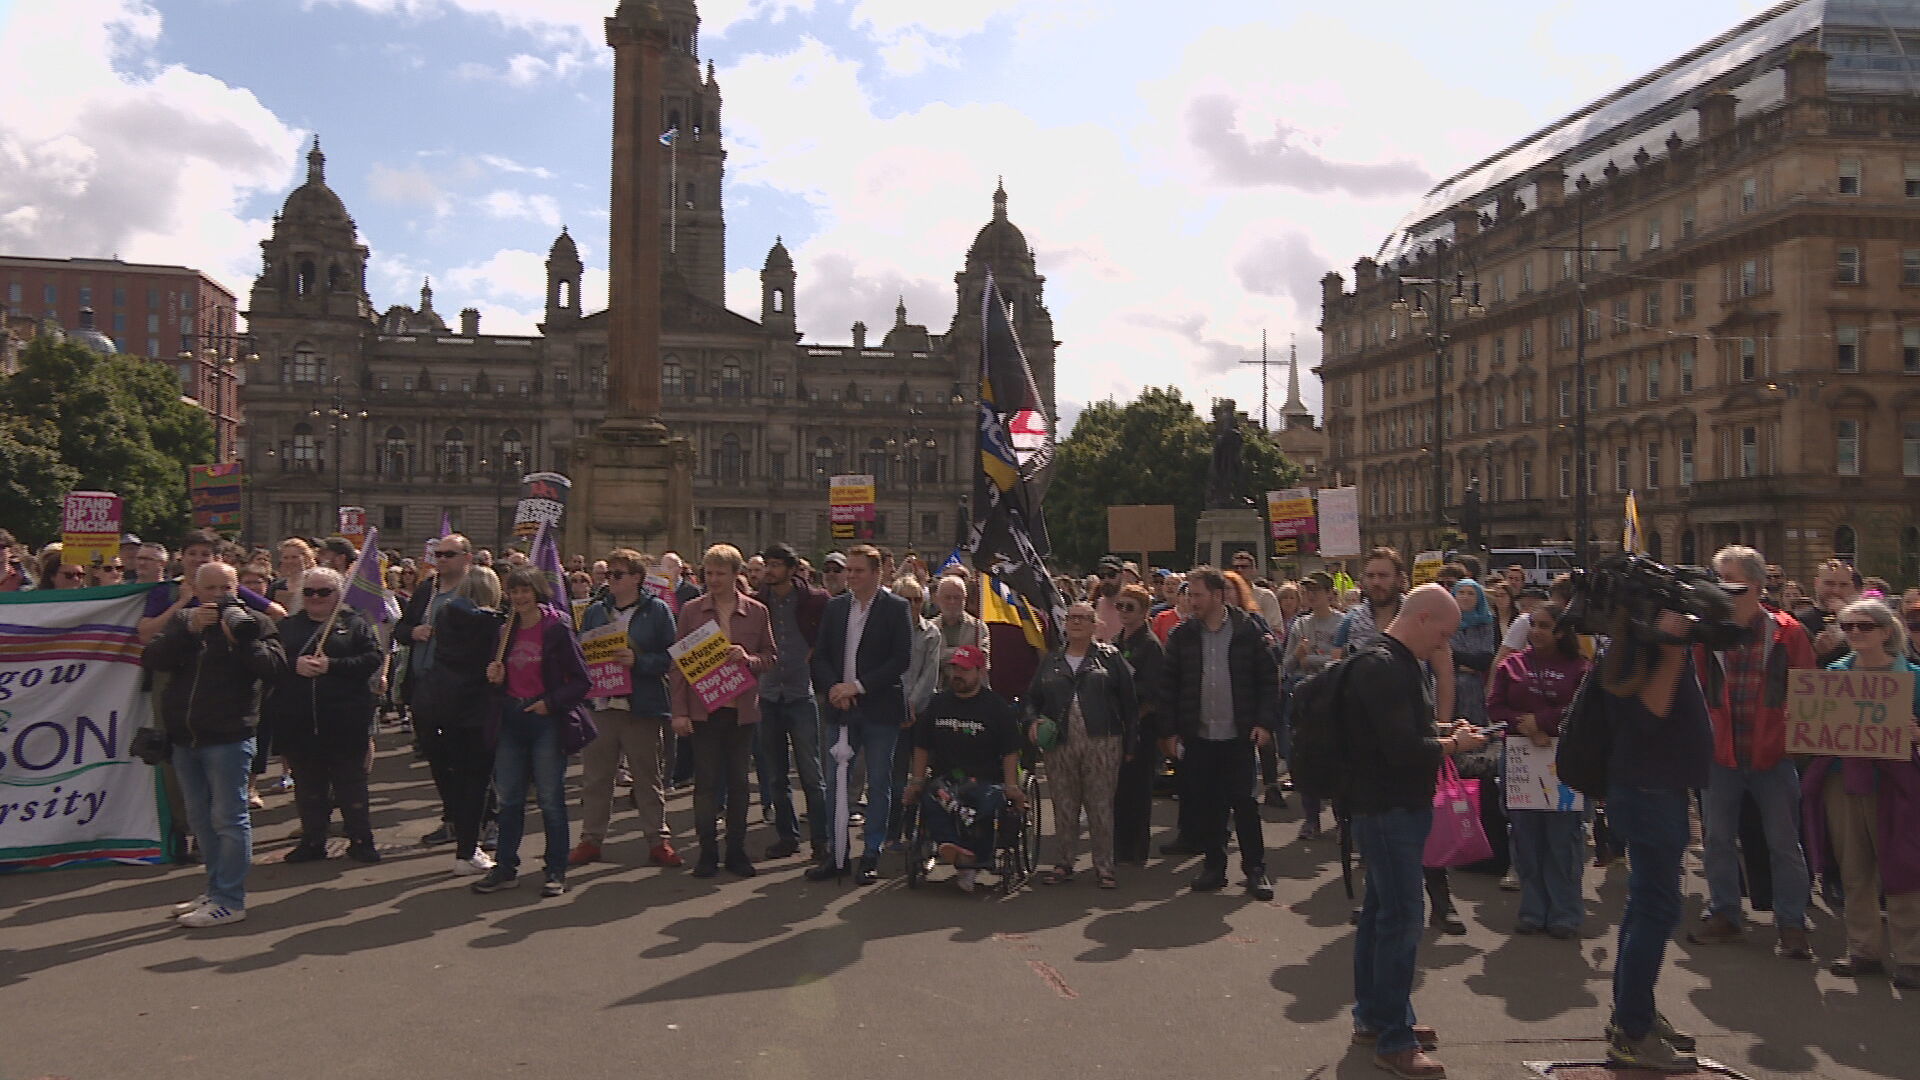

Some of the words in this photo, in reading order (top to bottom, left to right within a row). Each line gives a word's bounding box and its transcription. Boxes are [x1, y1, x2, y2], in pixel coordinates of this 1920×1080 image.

[67, 497, 113, 510] STAND
[67, 509, 88, 520] UP
[91, 509, 109, 521] TO
[66, 520, 120, 533] RACISM
[680, 637, 727, 669] Refugees
[605, 663, 624, 675] the
[695, 674, 721, 694] Stop
[719, 663, 739, 679] the
[597, 675, 625, 691] right
[703, 687, 721, 704] far
[720, 672, 747, 695] right
[1794, 674, 1899, 699] STAND
[1798, 699, 1838, 721] UP
[1854, 701, 1887, 724] TO
[0, 711, 118, 770] ON
[1792, 722, 1902, 754] RACISM
